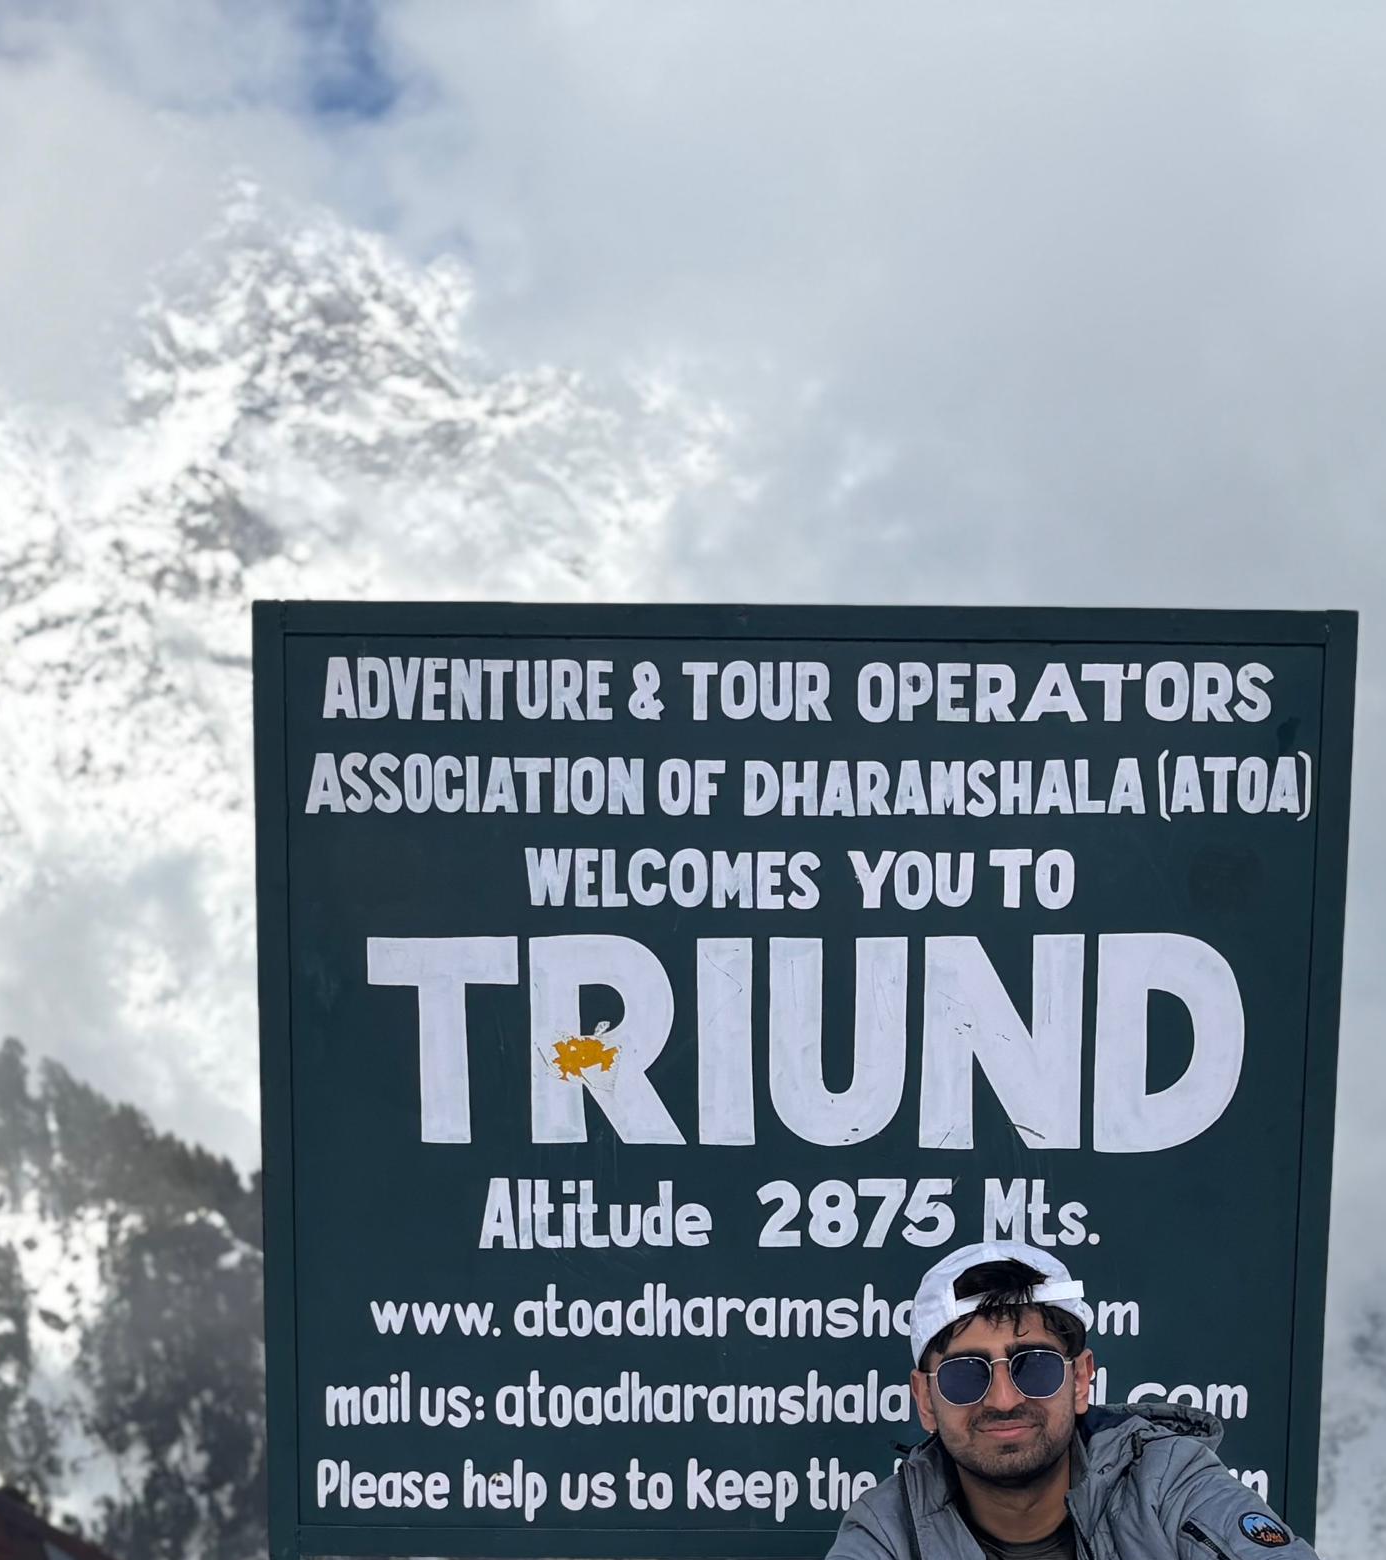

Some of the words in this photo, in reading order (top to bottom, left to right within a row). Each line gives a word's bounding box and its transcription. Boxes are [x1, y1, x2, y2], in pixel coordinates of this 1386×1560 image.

[322, 656, 614, 721] ADVENTURE
[627, 660, 665, 721] &
[681, 660, 833, 722] TOUR
[857, 660, 1274, 723] OPERATORS
[304, 752, 645, 815] ASSOCIATION
[658, 758, 726, 816] OF
[743, 757, 1146, 818] DHARAMSHALA
[1157, 749, 1312, 822] (ATOA)
[524, 847, 821, 910] WELCOMES
[847, 850, 975, 911] YOU
[988, 848, 1075, 910] TO
[366, 932, 1245, 1154] TRIUND
[478, 1177, 713, 1250] Altitude
[756, 1178, 956, 1248] 2875
[983, 1177, 1100, 1247] Mts.
[325, 1370, 411, 1427] mail
[419, 1385, 485, 1429] us:
[316, 1458, 451, 1510] Please
[463, 1458, 548, 1523] help
[560, 1471, 617, 1511] us
[625, 1457, 673, 1511] to
[686, 1457, 799, 1523] keep
[806, 1457, 878, 1512] the
